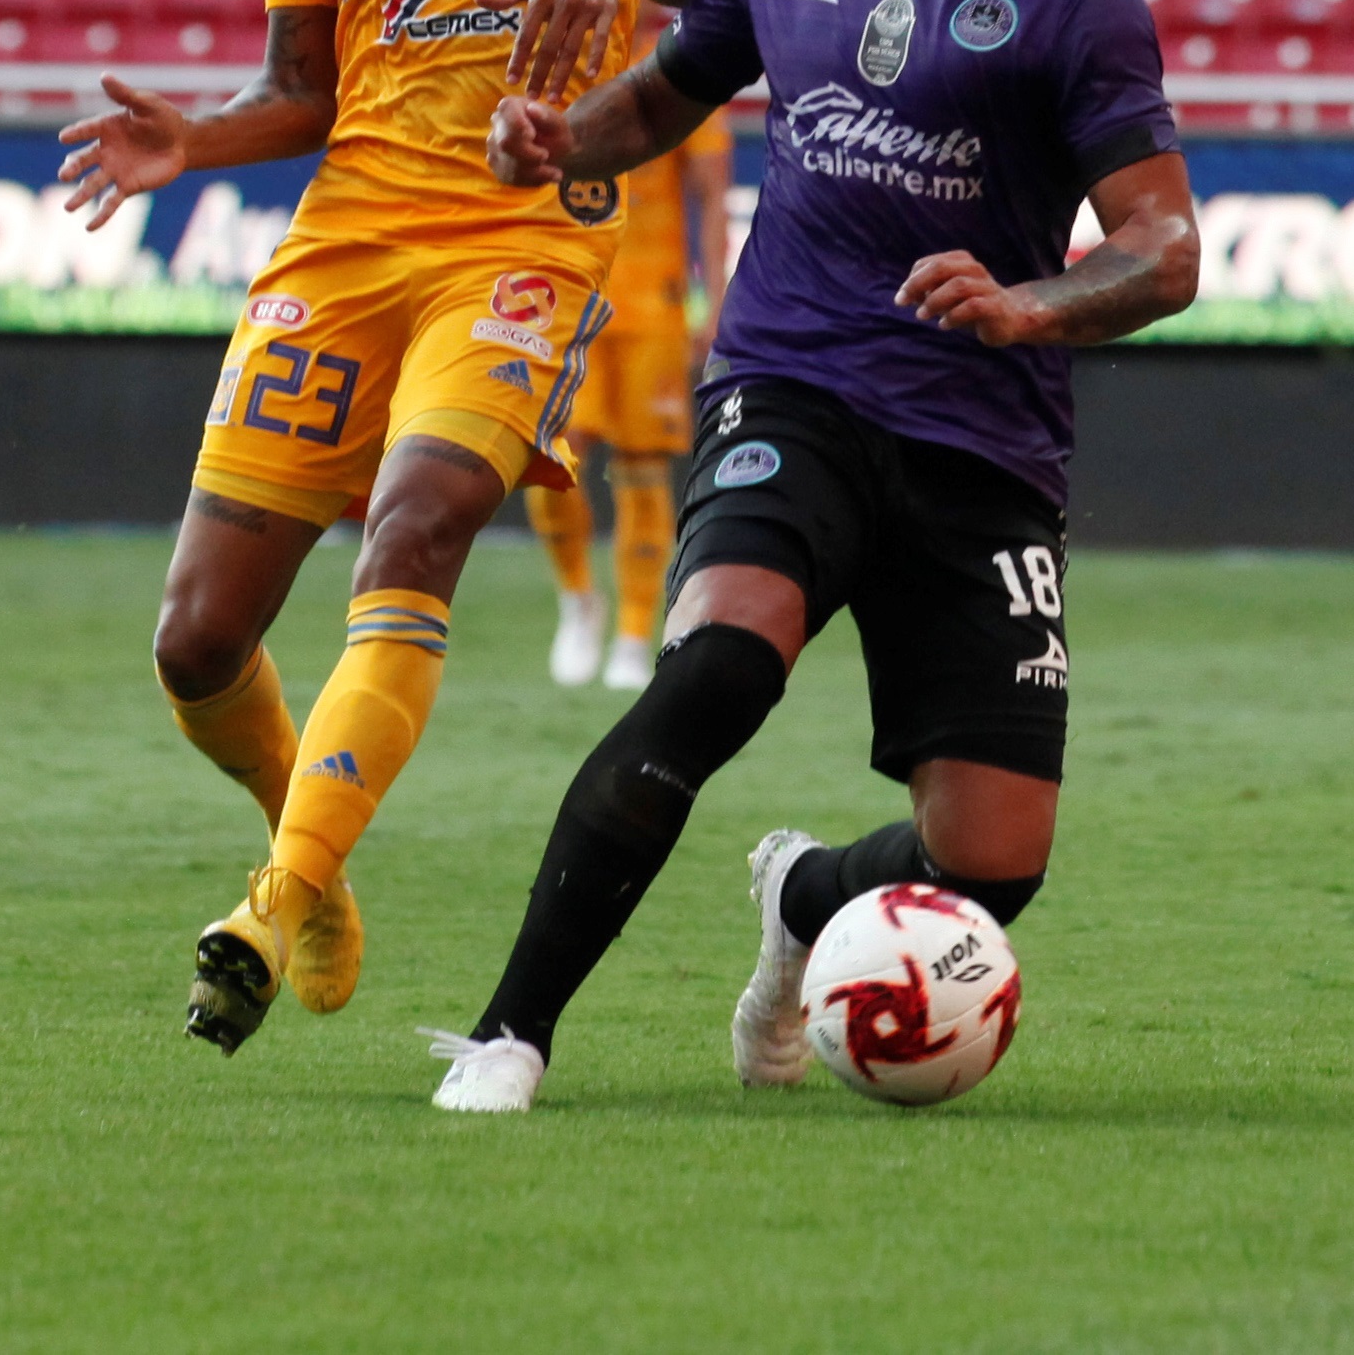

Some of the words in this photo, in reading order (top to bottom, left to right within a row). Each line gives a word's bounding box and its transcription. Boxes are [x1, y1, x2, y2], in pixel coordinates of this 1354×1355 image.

[783, 81, 982, 167] Caliente
[803, 146, 983, 201] caliente.mx
[244, 341, 361, 446] 23
[992, 545, 1062, 619] 18
